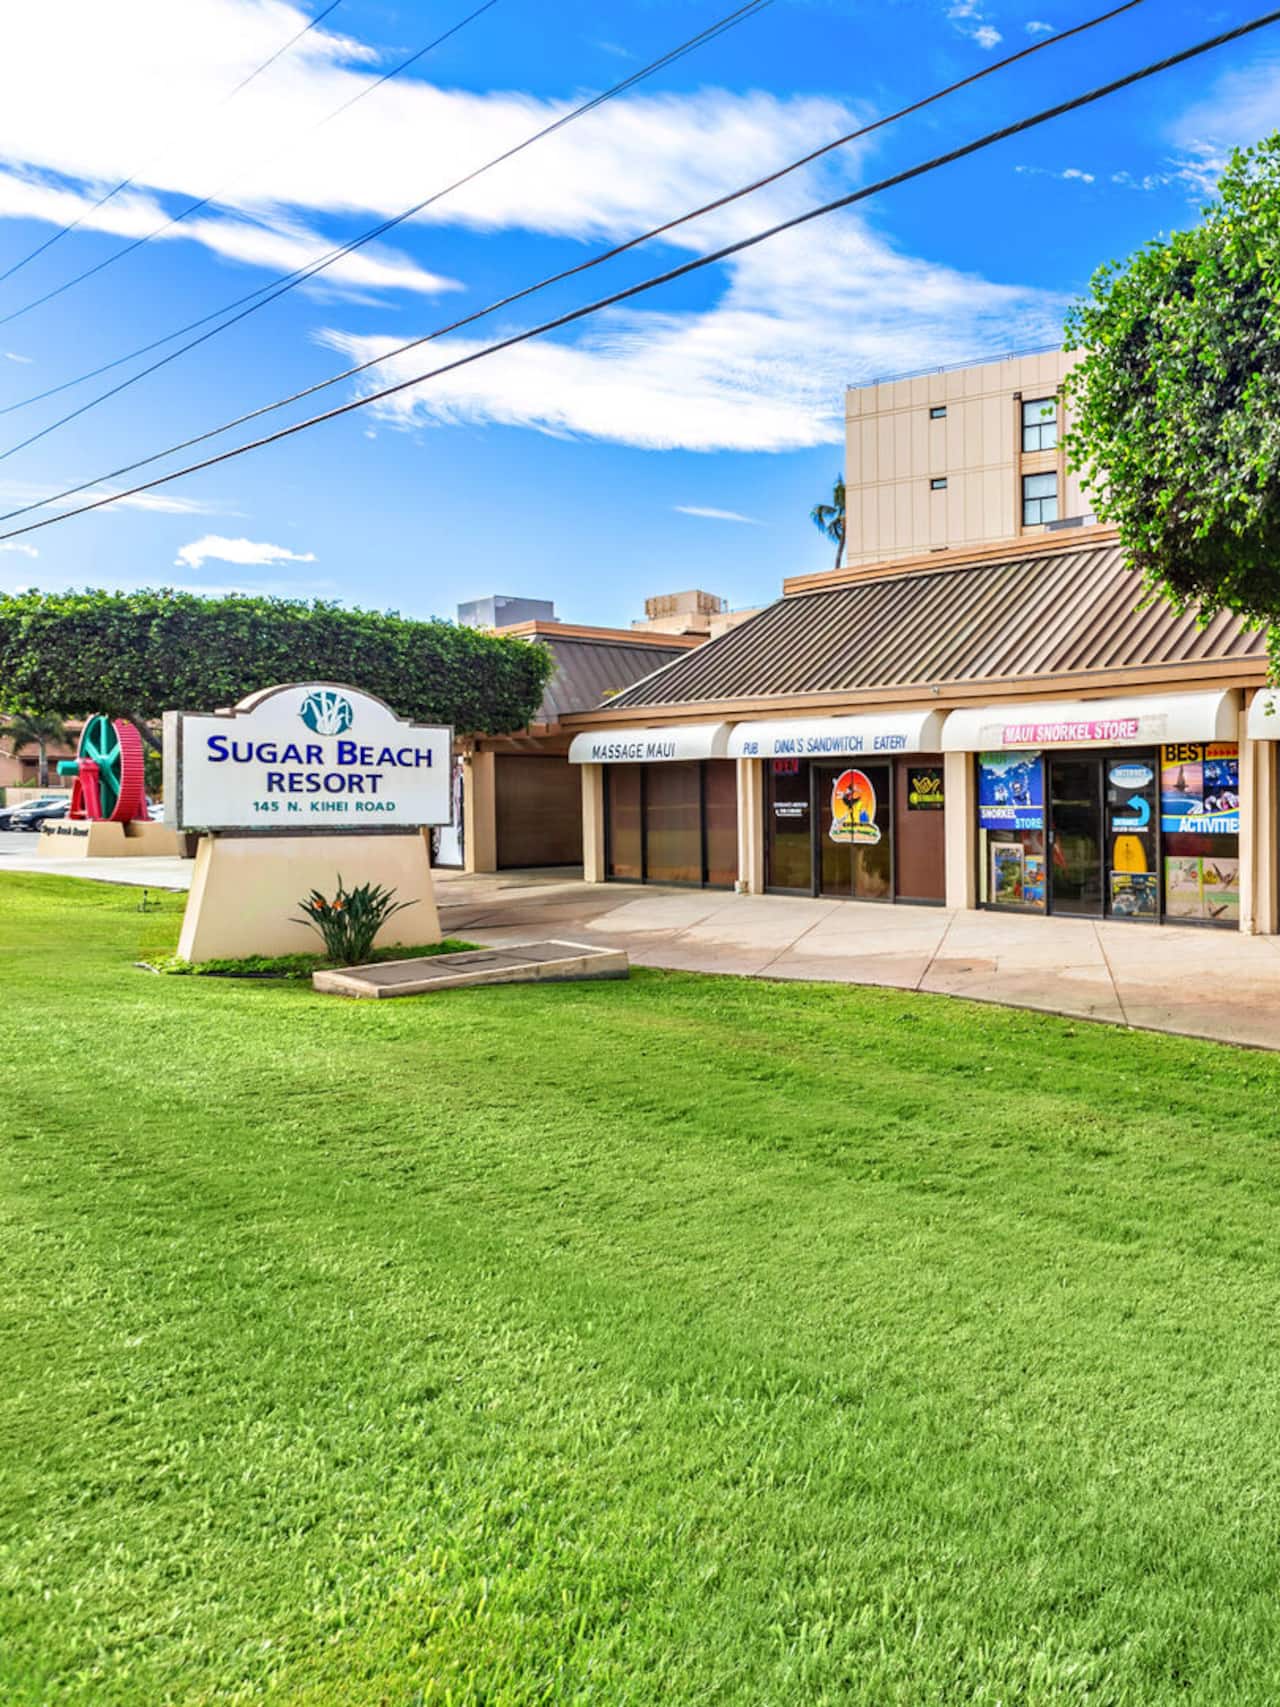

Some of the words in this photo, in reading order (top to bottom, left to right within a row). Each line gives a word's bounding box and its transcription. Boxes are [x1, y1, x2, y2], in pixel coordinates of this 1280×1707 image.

[1004, 727, 1034, 742] MAUI
[1036, 724, 1092, 741] SNORKEL
[1094, 720, 1136, 739] STORE
[207, 735, 324, 765] SUGAR
[337, 740, 433, 768] BEACH
[592, 744, 643, 759] MASSAGE
[646, 742, 676, 757] MAUI
[743, 742, 759, 755] PUB
[807, 736, 863, 752] SANDWITCH
[873, 735, 907, 750] EATERY
[1166, 744, 1208, 761] BEST
[267, 772, 383, 793] RESORT
[253, 801, 279, 812] 145
[287, 802, 302, 812] N.
[310, 802, 348, 812] KIHEI
[355, 802, 396, 812] ROAD
[1015, 818, 1043, 829] STORE
[1178, 817, 1239, 833] ACTIVITIE
